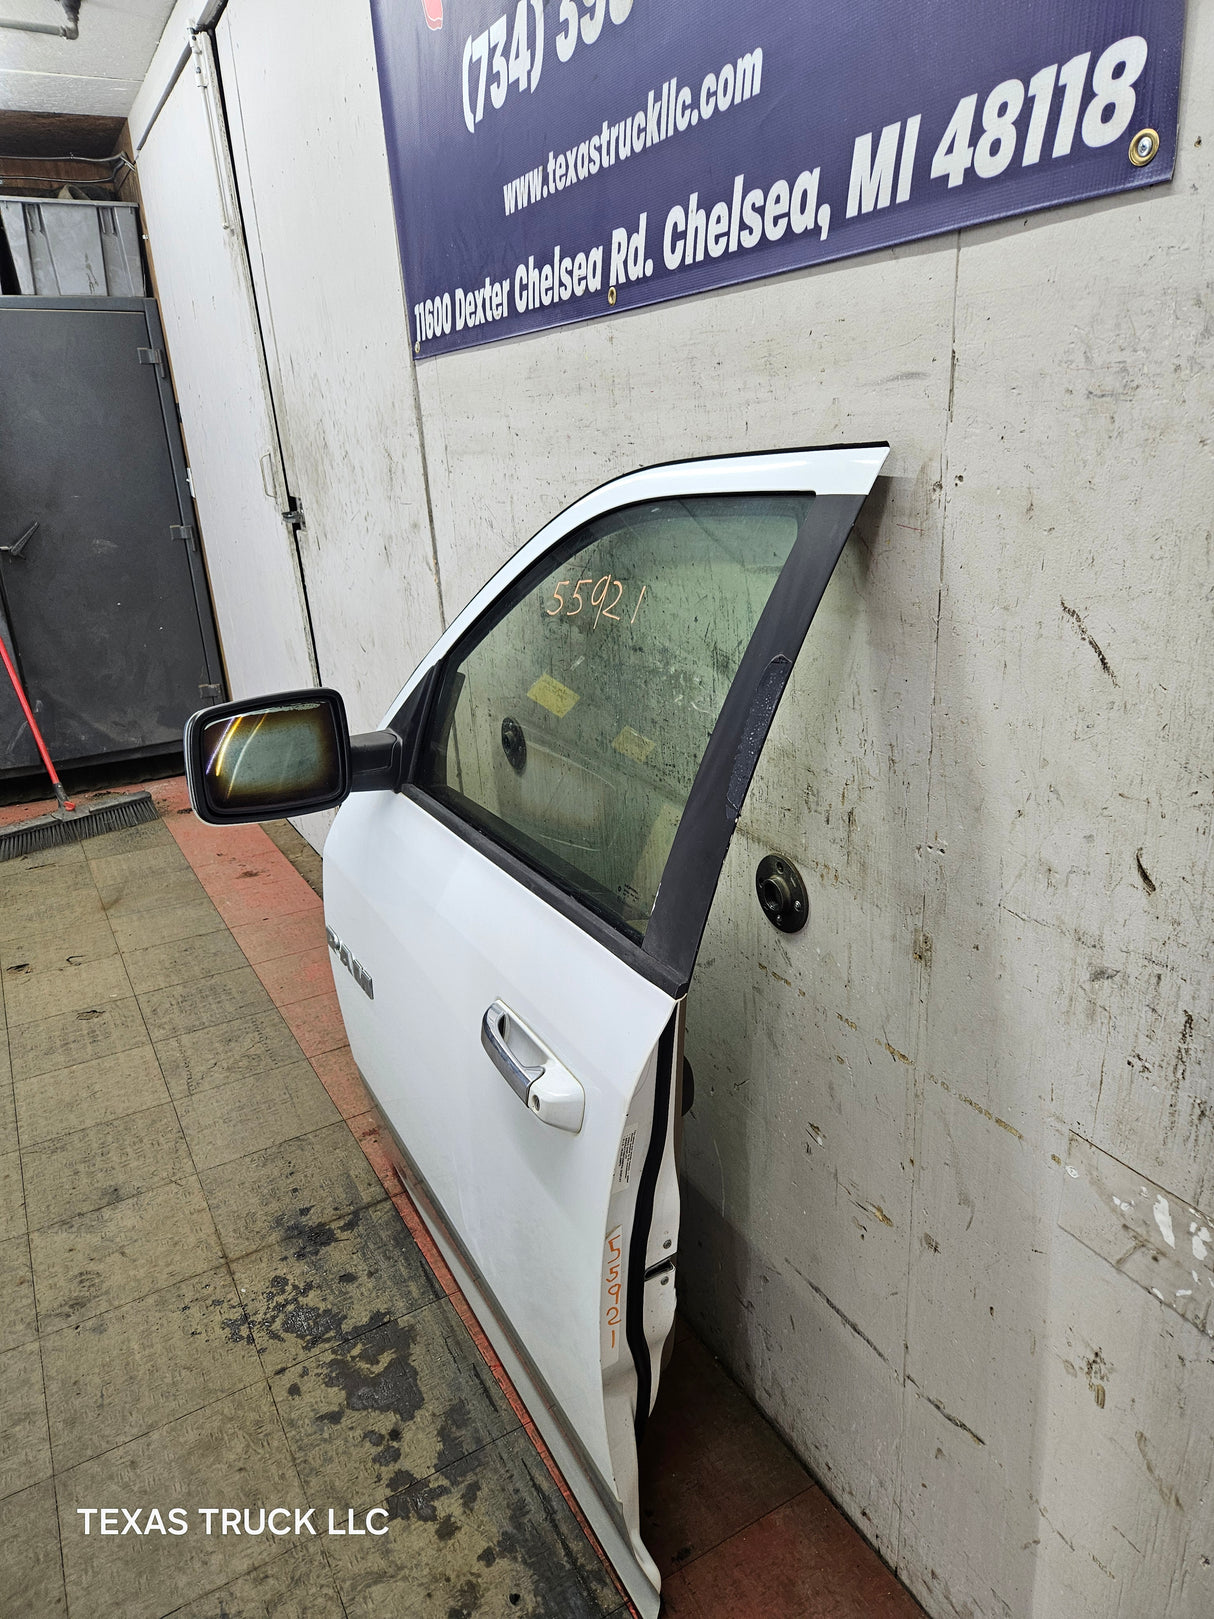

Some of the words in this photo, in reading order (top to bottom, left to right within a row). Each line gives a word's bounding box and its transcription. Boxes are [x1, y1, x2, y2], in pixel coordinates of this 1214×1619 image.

[462, 0, 544, 133] (734)
[556, 0, 634, 62] 39
[503, 47, 763, 216] www.texastruckllc.com
[414, 292, 452, 342] 11600
[455, 274, 510, 331] Dexter
[514, 244, 604, 313] Chelsea
[609, 212, 653, 286] Rd.
[663, 167, 831, 270] Chelsea,
[845, 114, 922, 219] MI
[930, 35, 1148, 189] 48118
[546, 574, 646, 630] 55921
[605, 1234, 622, 1349] 55921
